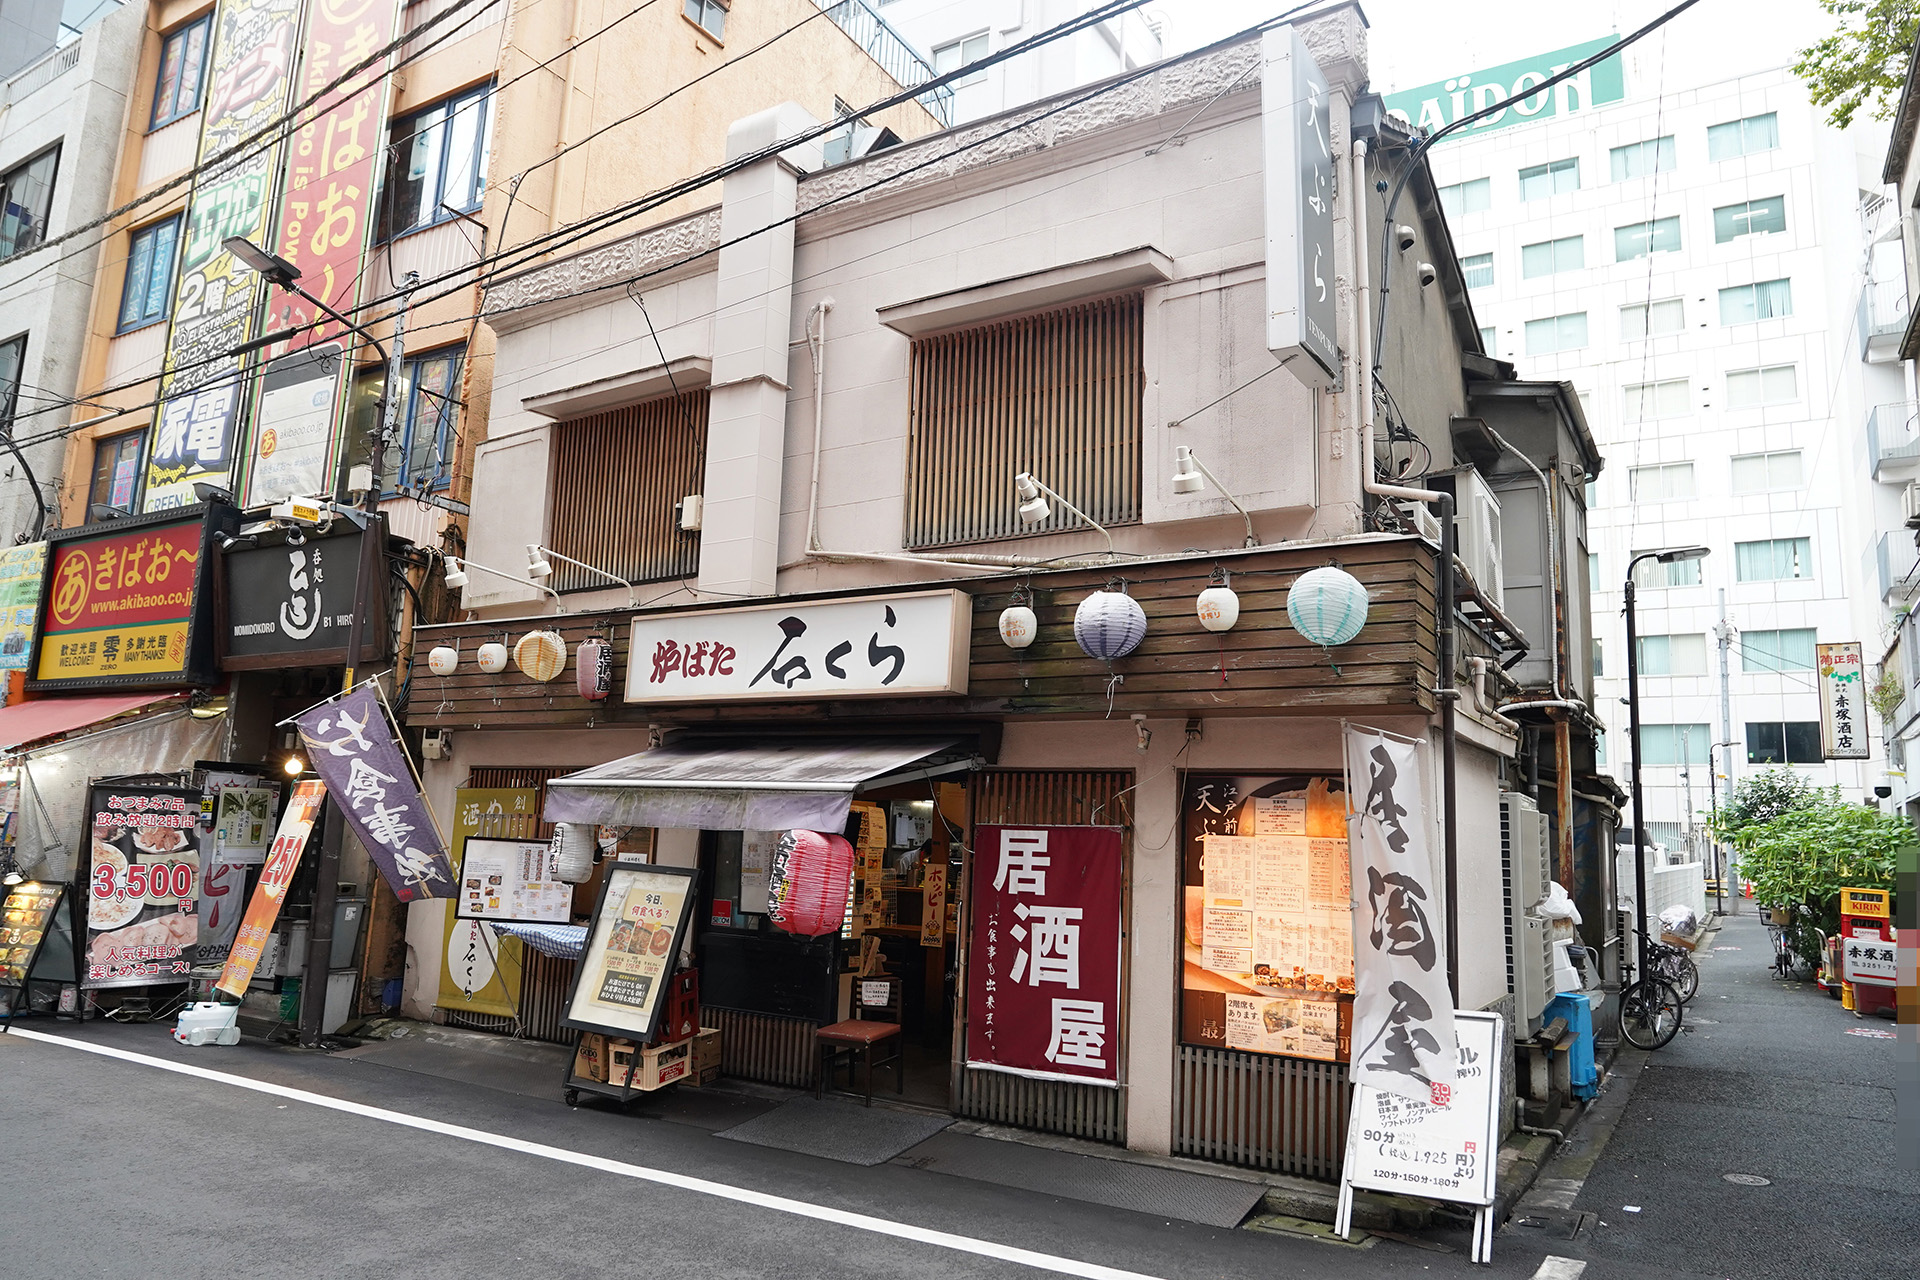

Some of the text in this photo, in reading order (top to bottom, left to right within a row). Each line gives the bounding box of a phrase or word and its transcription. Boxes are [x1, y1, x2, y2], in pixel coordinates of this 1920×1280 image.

[207, 20, 292, 126] アニメ
[1307, 79, 1329, 302] 天ぷら
[186, 172, 267, 266] エアガン
[175, 270, 228, 323] 2階
[225, 285, 252, 311] HOME
[1307, 316, 1336, 359] TENPURA
[154, 374, 235, 461] 家電
[234, 621, 276, 637] NOMIDOKORO
[323, 616, 332, 628] B1
[649, 604, 907, 688] 炉ばた 石くら
[59, 649, 167, 671] WELCOME!! ZERO MANY THANKS!!
[1820, 654, 1859, 665] 菊正宗
[1835, 695, 1853, 748] 赤塚酒店
[108, 795, 186, 811] おつまみ7品
[1223, 783, 1239, 835] 江戸前
[96, 812, 195, 828] 飲み放題2時間
[259, 834, 304, 888] 250
[93, 862, 193, 903] 3,500
[928, 866, 943, 920] ホッピー
[178, 898, 194, 913] 円
[645, 893, 662, 905] 今日、
[1852, 902, 1881, 911] KIRIN
[104, 945, 183, 962] 人気料理が
[992, 829, 1106, 1069] 居酒屋
[1848, 946, 1896, 962] 赤塚酒
[89, 961, 191, 980] 楽しめるコース!
[462, 942, 477, 1002] 石くら
[984, 913, 999, 1050] お食事も出来ます。
[1228, 999, 1255, 1010] 2階席も
[1378, 1105, 1399, 1114] 日本酒
[1379, 1105, 1452, 1121] ワイン ノンアルビール
[1381, 1116, 1425, 1128] ソフトドリンク
[1363, 1130, 1395, 1143] 90分
[1464, 1141, 1477, 1153] 円
[1453, 1167, 1475, 1179] より
